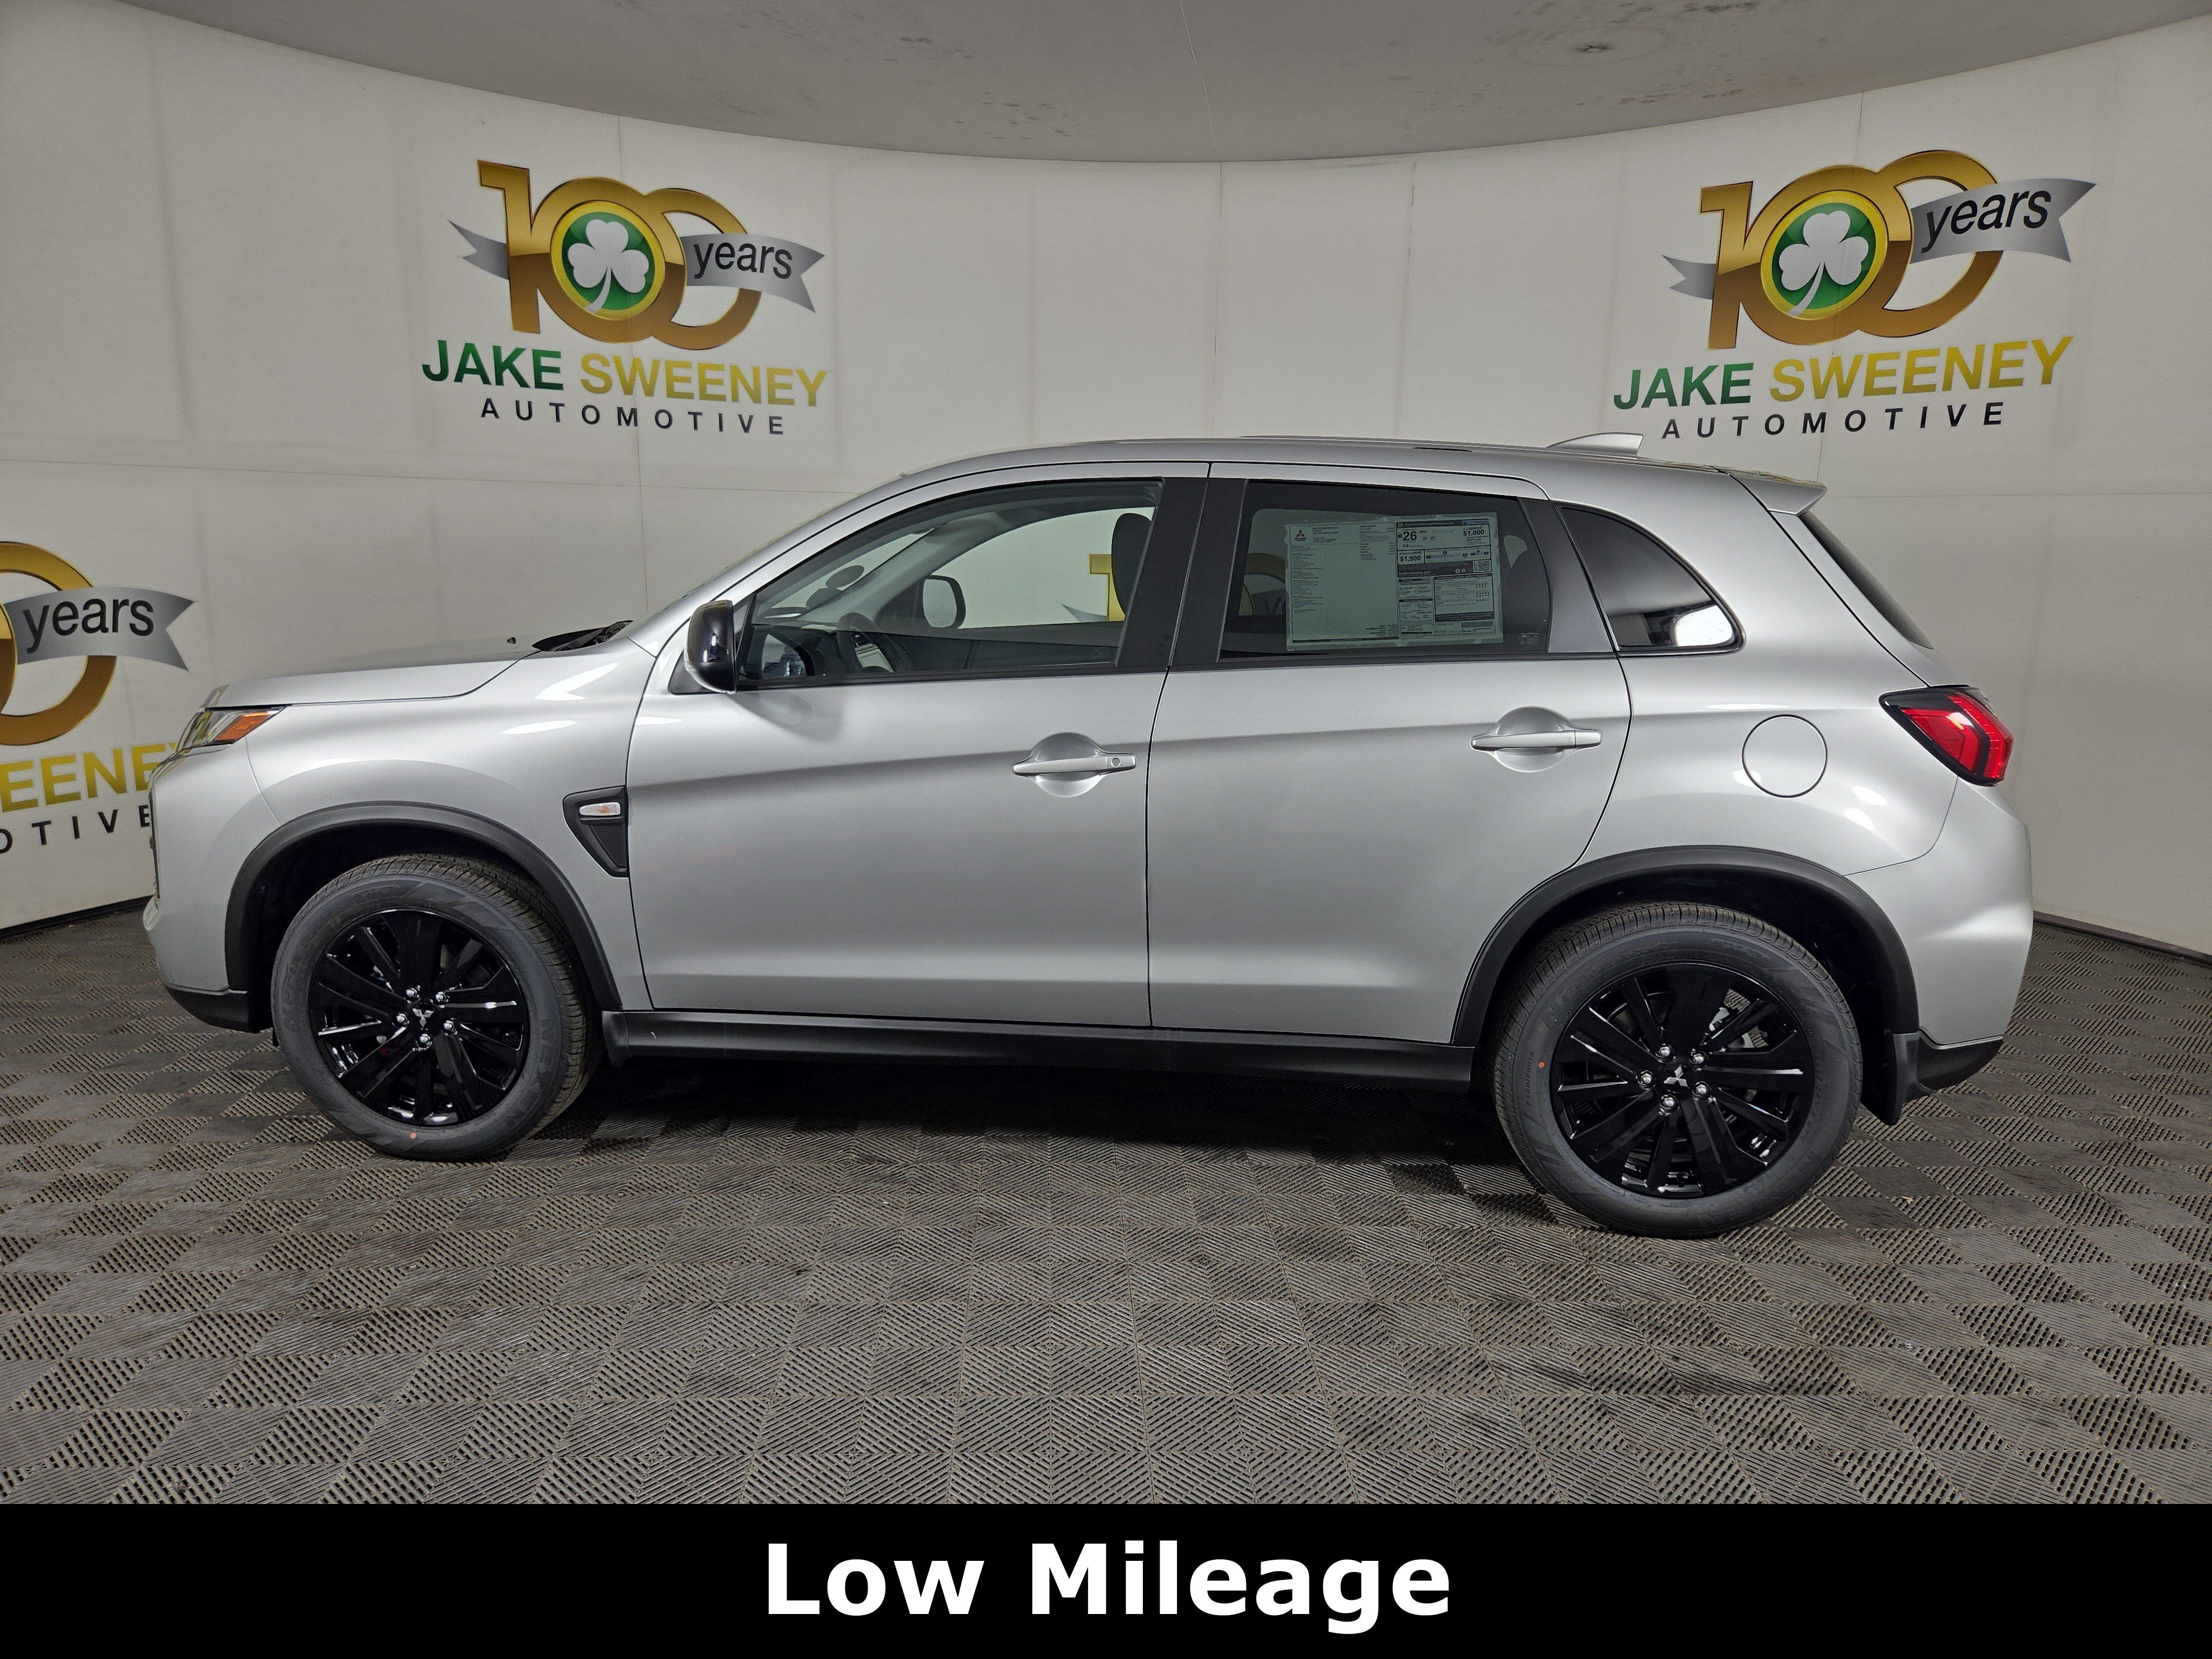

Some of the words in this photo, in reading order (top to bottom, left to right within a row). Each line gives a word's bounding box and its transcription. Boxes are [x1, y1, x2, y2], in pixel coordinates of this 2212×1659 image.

[477, 160, 761, 350] 100
[693, 242, 793, 279] years
[1699, 150, 2004, 350] 100
[1921, 189, 2052, 254] years
[422, 339, 563, 390] JAKE
[581, 353, 827, 407] SWEENEY
[1613, 362, 1754, 410] JAKE
[1770, 336, 2074, 402] SWEENEY
[481, 398, 783, 435] AUTOMOTIVE
[1661, 401, 2004, 439] AUTOMOTIVE
[1403, 531, 1417, 541] 26
[23, 599, 154, 653] years
[0, 741, 177, 812] EENE
